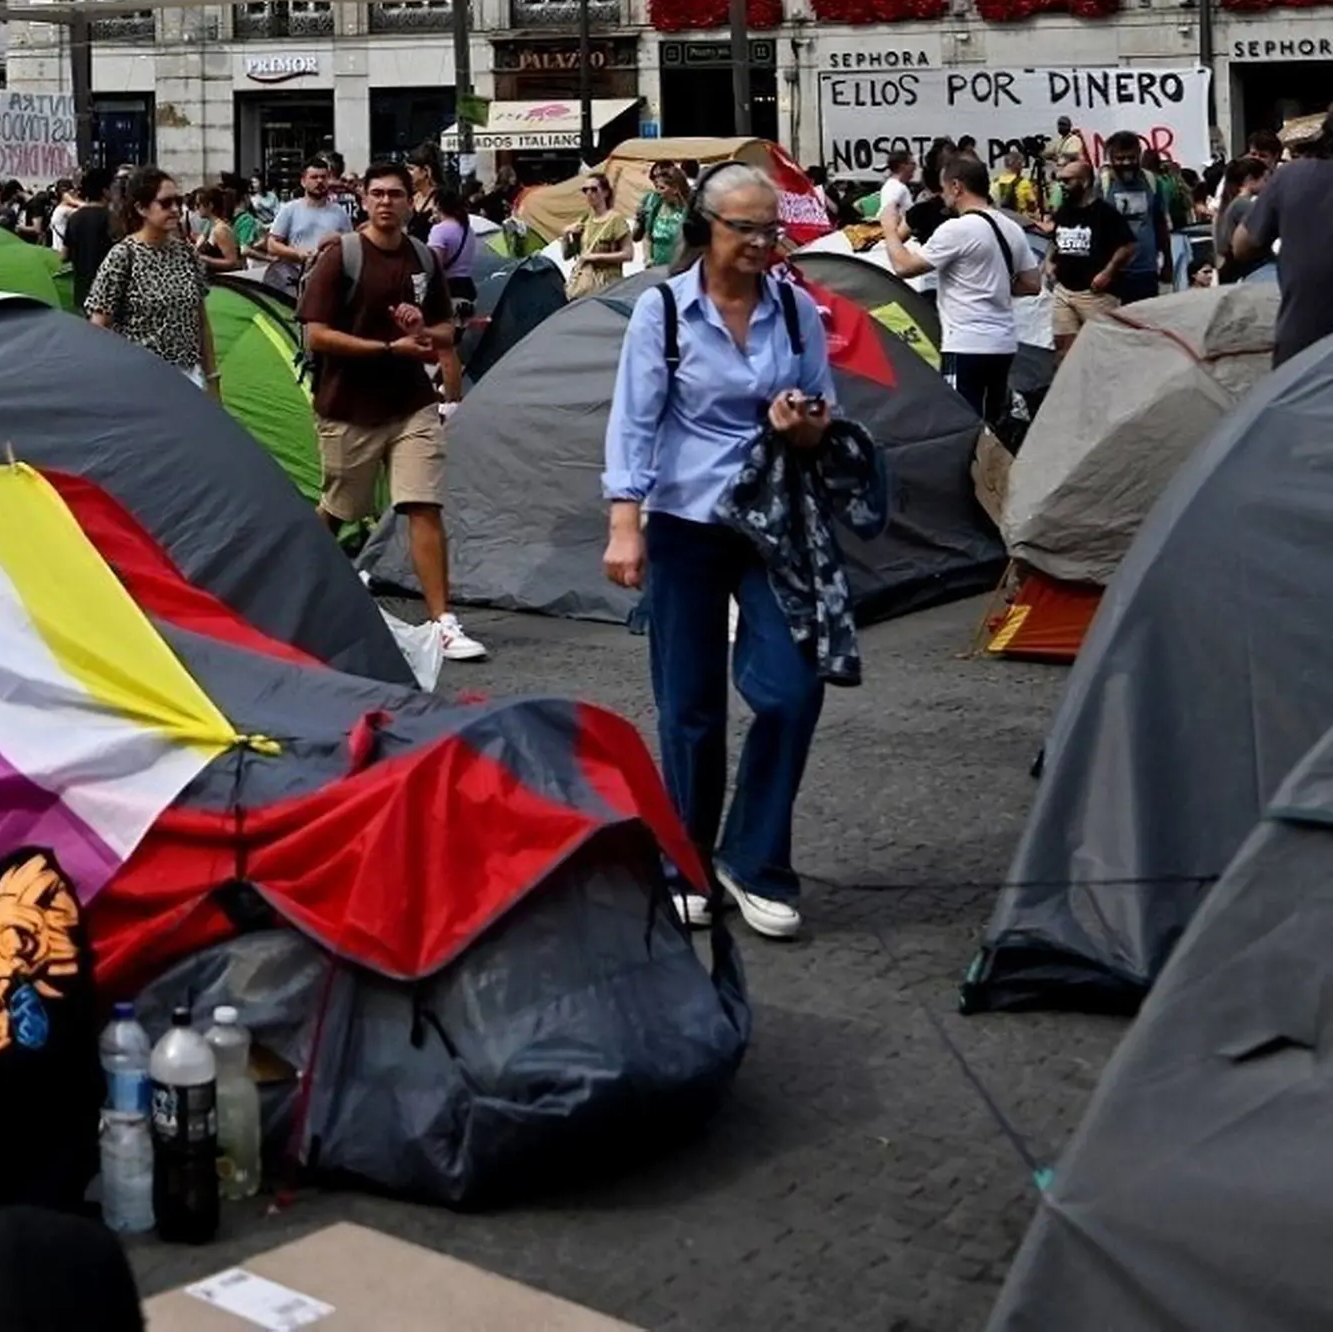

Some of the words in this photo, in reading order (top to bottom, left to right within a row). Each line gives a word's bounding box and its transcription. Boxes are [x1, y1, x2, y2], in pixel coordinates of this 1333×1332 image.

[1234, 39, 1332, 57] SEPHOR
[247, 55, 318, 72] PRIMOR
[519, 50, 605, 69] PALAZO
[829, 50, 930, 68] SEPHORA
[831, 72, 920, 107] ELLOS
[947, 72, 1021, 106] POR
[1048, 67, 1185, 109] DINERO
[446, 136, 513, 148] HADOS
[519, 134, 583, 147] ITALIANO
[831, 136, 938, 172] NOSOT
